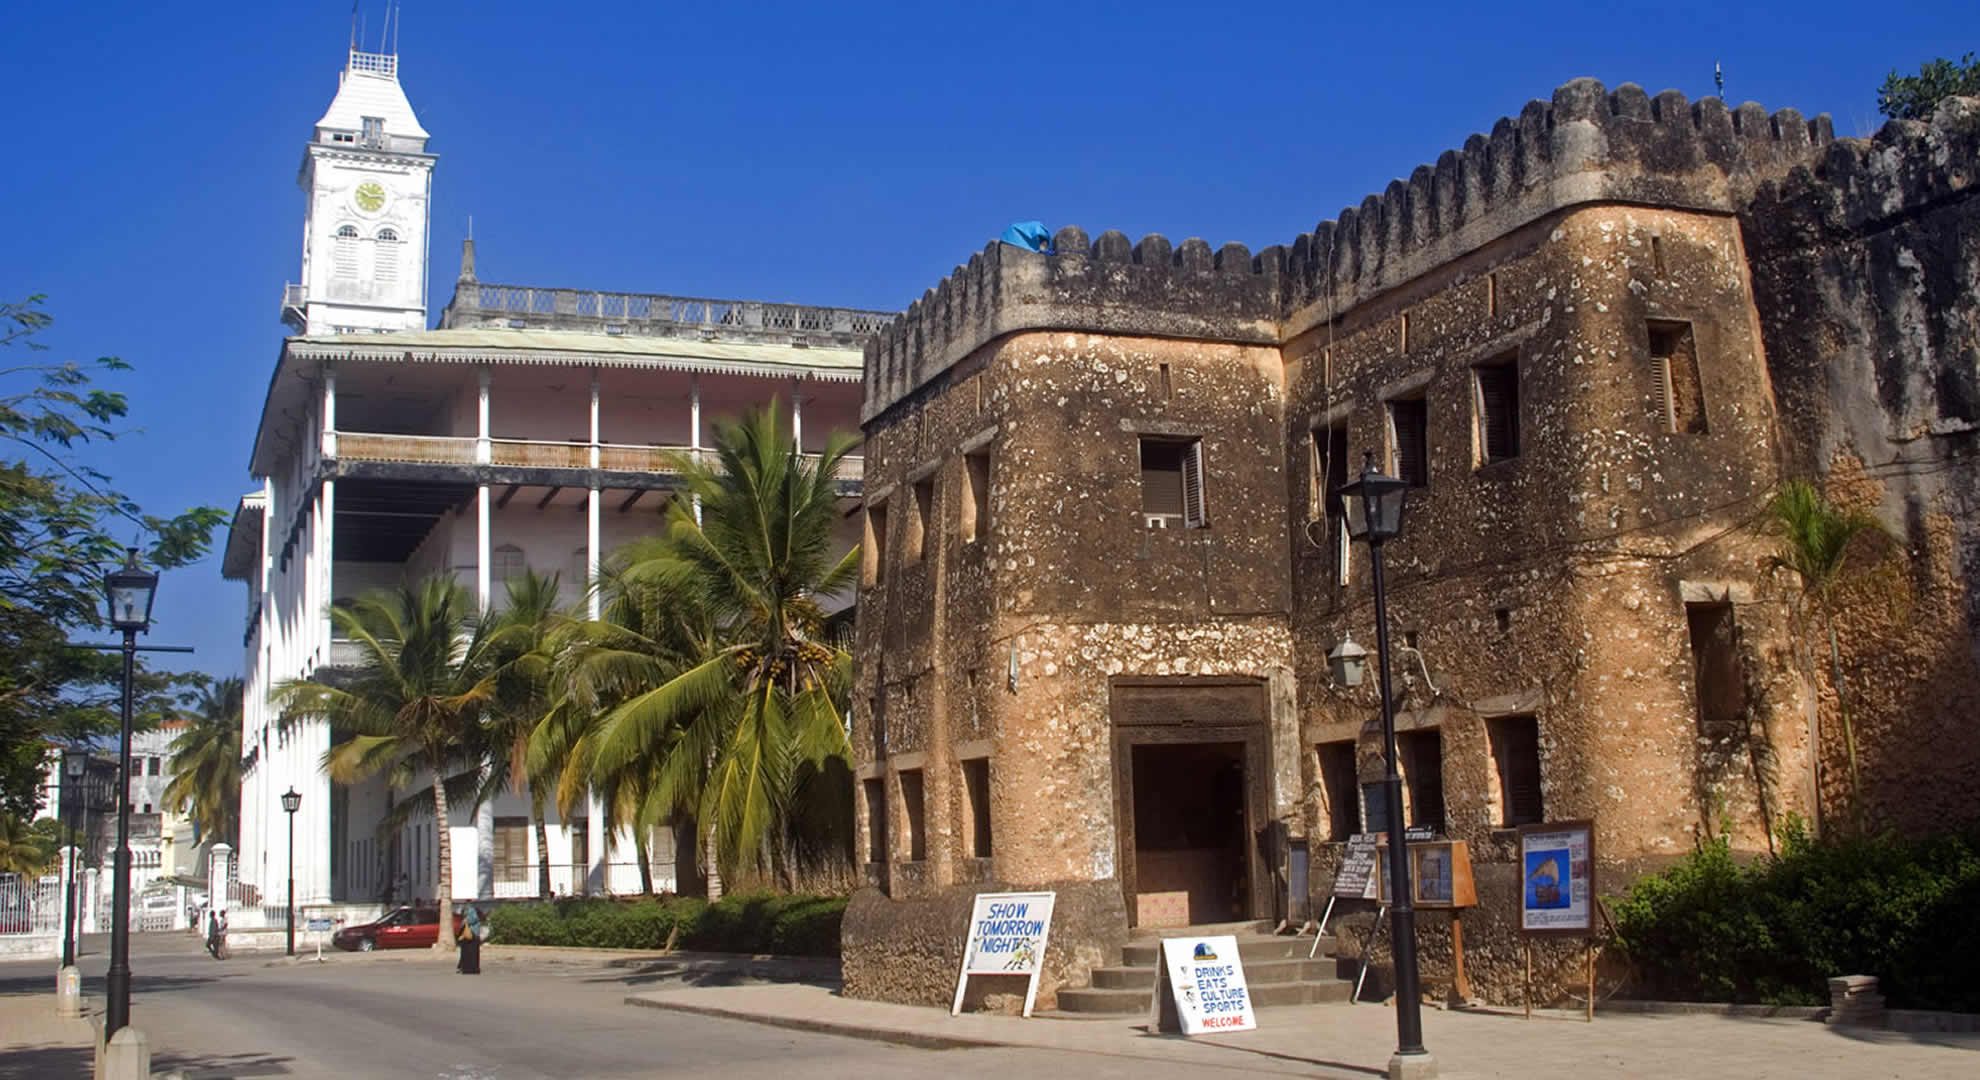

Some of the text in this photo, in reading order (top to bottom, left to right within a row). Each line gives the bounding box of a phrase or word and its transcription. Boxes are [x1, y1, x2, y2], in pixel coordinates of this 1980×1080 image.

[987, 903, 1028, 919] SHOW
[977, 920, 1044, 936] TOMORROW
[980, 937, 1020, 953] NIGHT
[1195, 965, 1234, 978] DRINKS
[1197, 977, 1228, 990] EATS
[1201, 988, 1245, 1001] CULTURE
[1204, 1000, 1244, 1013] SPORTS
[1202, 1015, 1244, 1028] WELCOME
